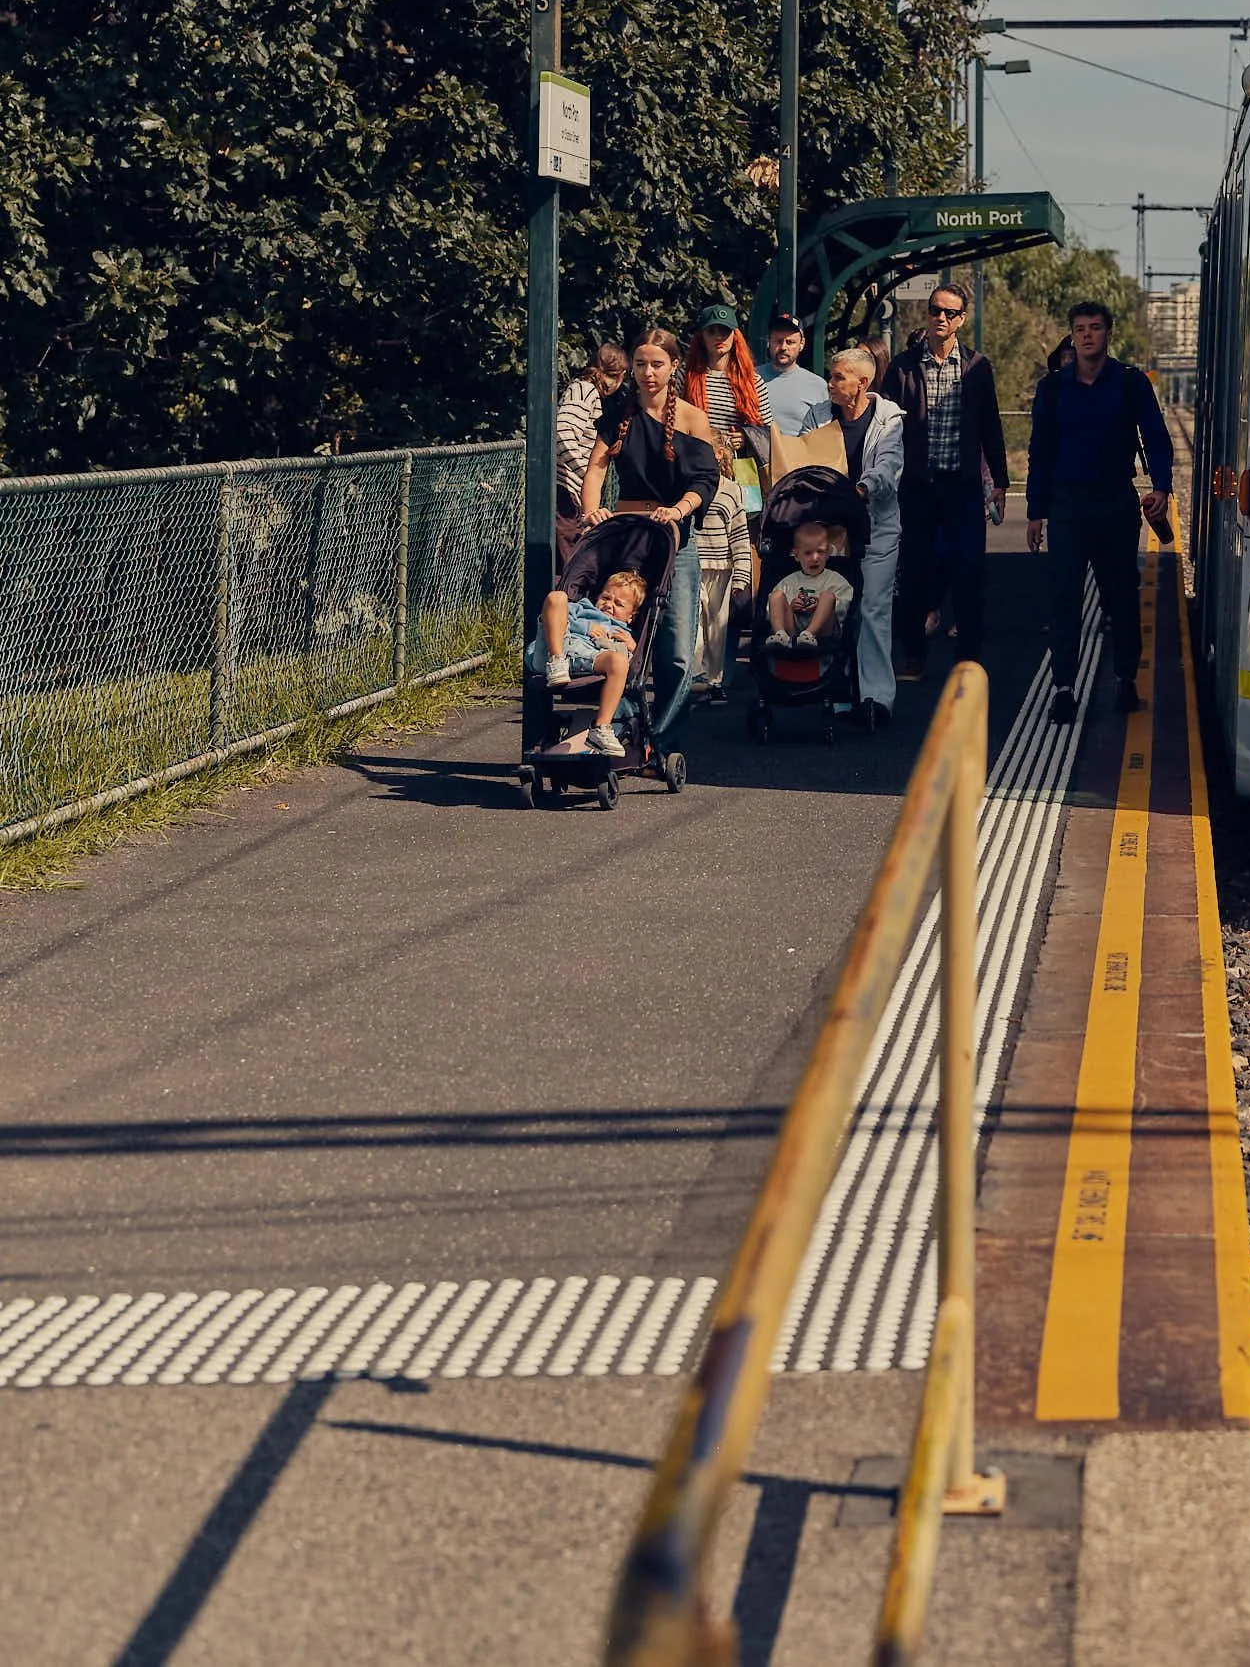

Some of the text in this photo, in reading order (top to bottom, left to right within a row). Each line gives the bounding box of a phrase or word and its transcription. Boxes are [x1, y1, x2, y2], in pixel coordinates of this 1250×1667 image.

[782, 144, 791, 159] 4
[937, 211, 1023, 226] North Port
